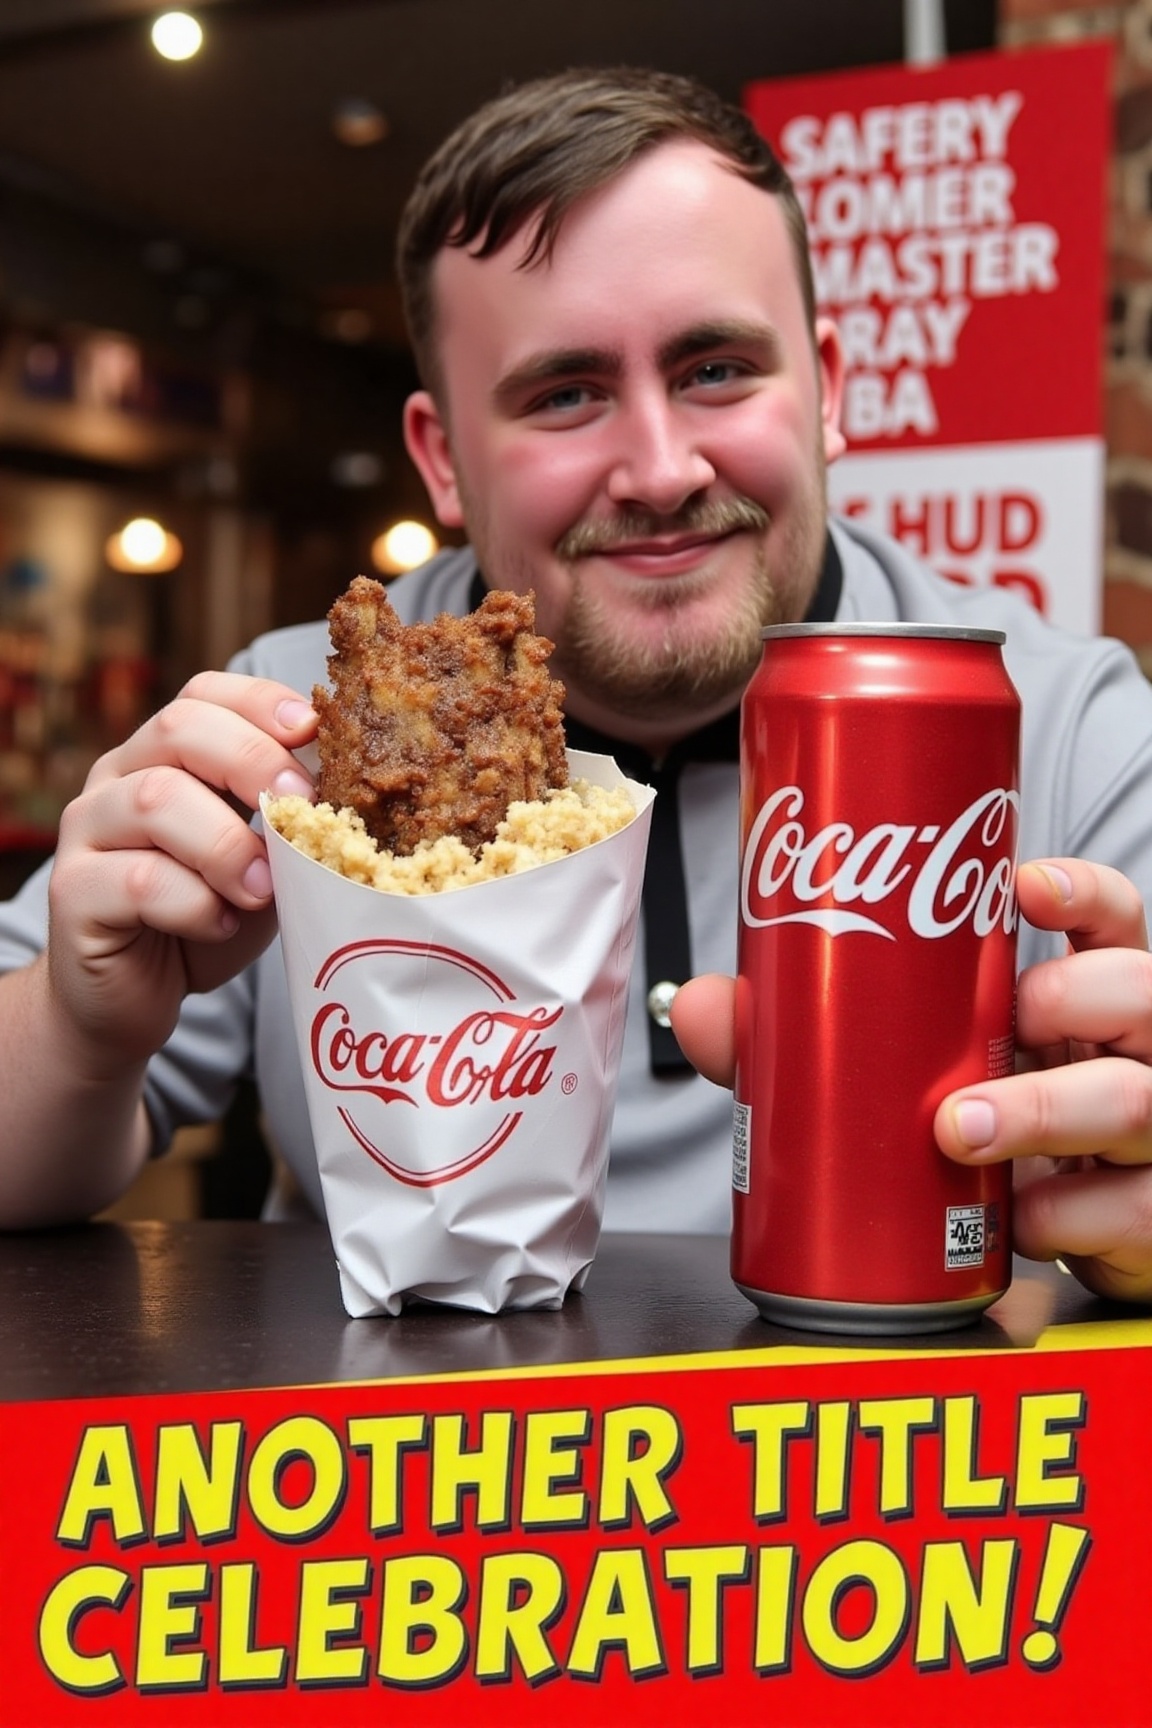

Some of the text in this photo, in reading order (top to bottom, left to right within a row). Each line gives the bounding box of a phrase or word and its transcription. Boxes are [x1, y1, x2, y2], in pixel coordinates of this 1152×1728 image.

[779, 90, 1023, 183] SAFERY
[812, 222, 1059, 305] MASTER
[888, 486, 1045, 560] HUD
[741, 785, 1020, 941] Coca-Col
[311, 1003, 564, 1108] Coca-Cola
